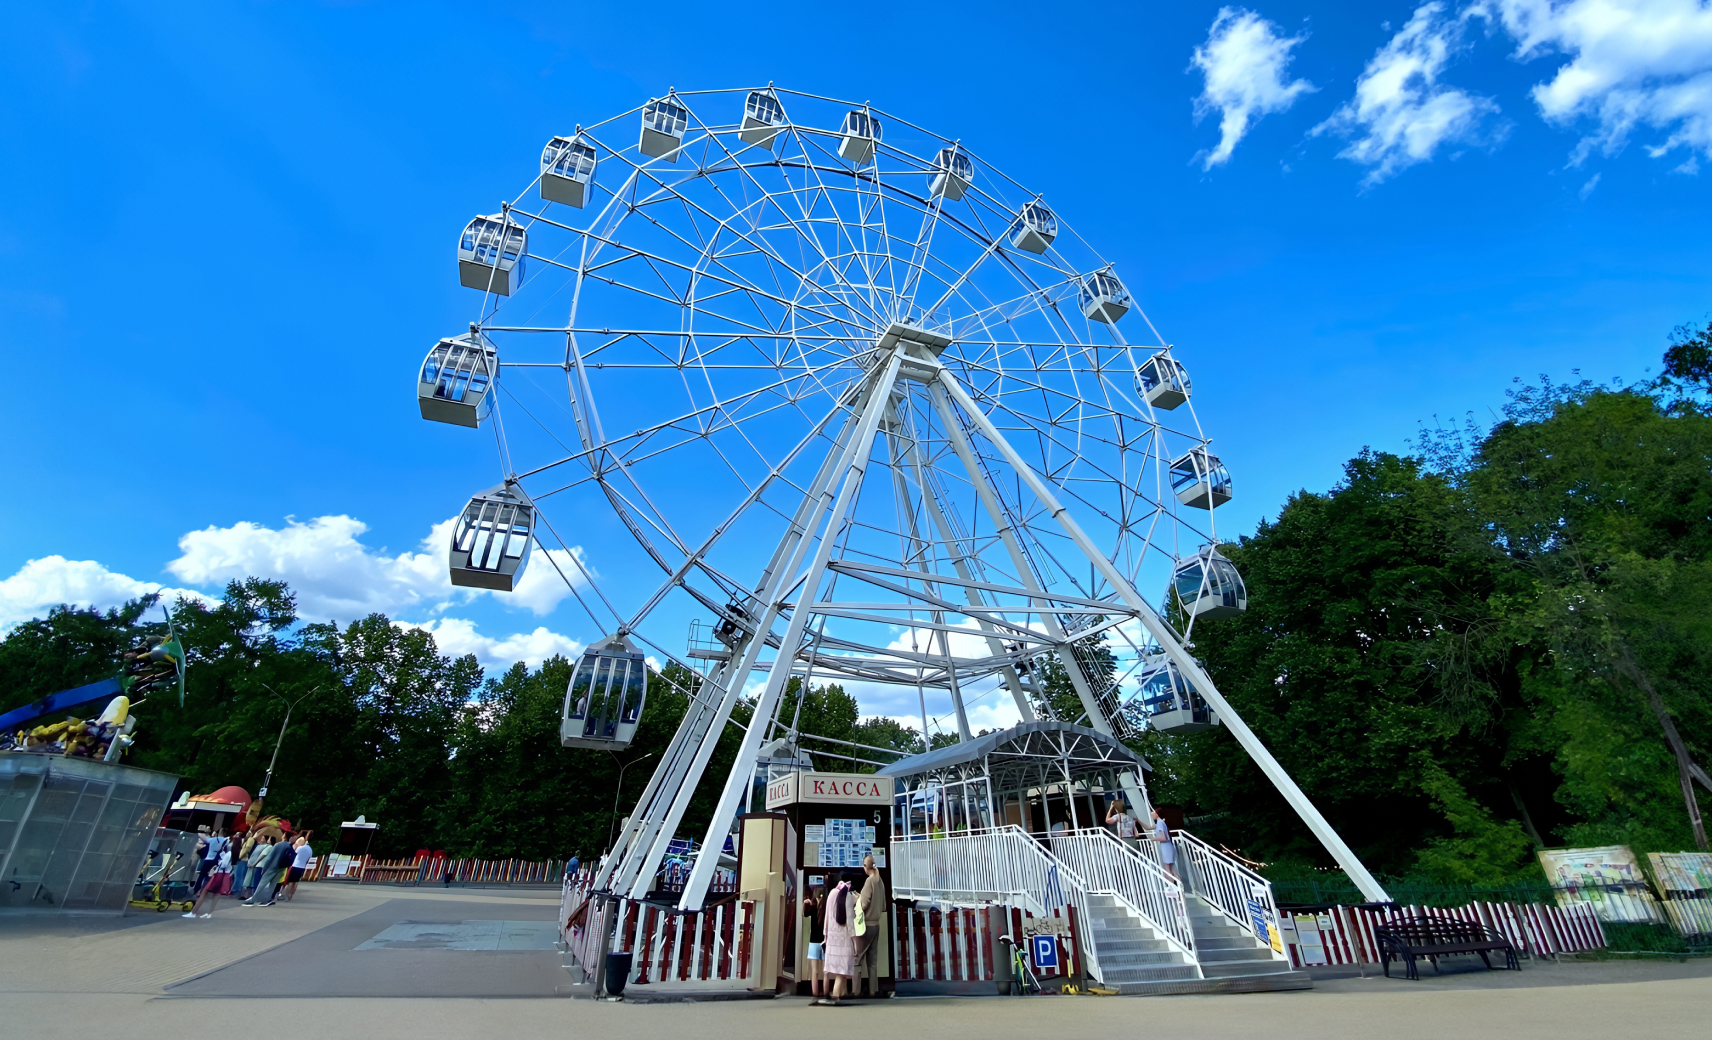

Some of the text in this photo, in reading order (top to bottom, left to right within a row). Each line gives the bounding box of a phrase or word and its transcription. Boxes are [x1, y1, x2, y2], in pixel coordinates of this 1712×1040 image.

[813, 780, 881, 797] КАССА
[873, 809, 881, 824] 5
[1038, 940, 1051, 964] P
